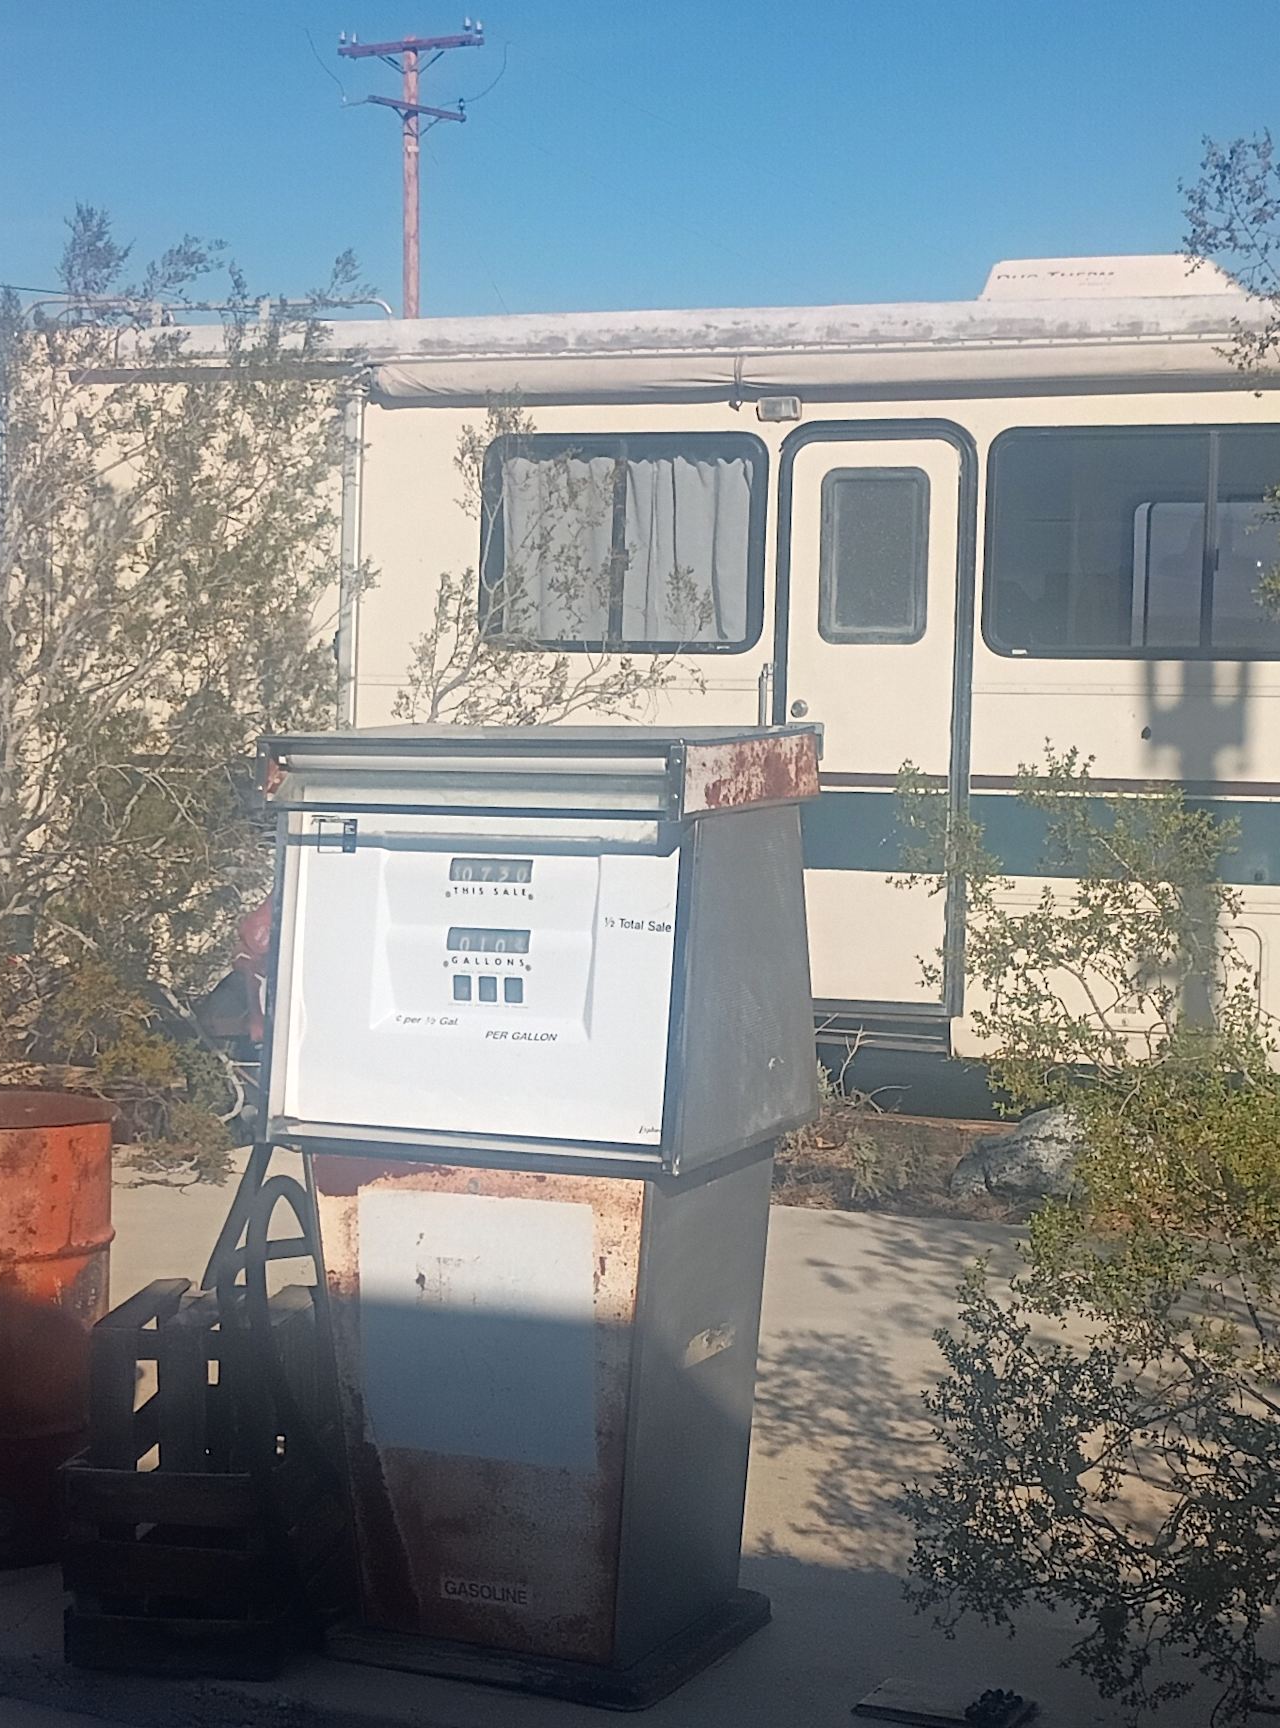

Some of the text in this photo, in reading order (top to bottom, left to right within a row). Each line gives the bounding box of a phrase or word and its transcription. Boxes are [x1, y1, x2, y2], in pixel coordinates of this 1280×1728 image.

[453, 886, 527, 897] THIS SALE
[619, 918, 644, 930] Total
[647, 920, 672, 933] Sale
[451, 956, 525, 967] GALLONS
[403, 1015, 421, 1025] per
[485, 1030, 558, 1042] PER GALLON
[444, 1580, 528, 1605] GASOLINE
